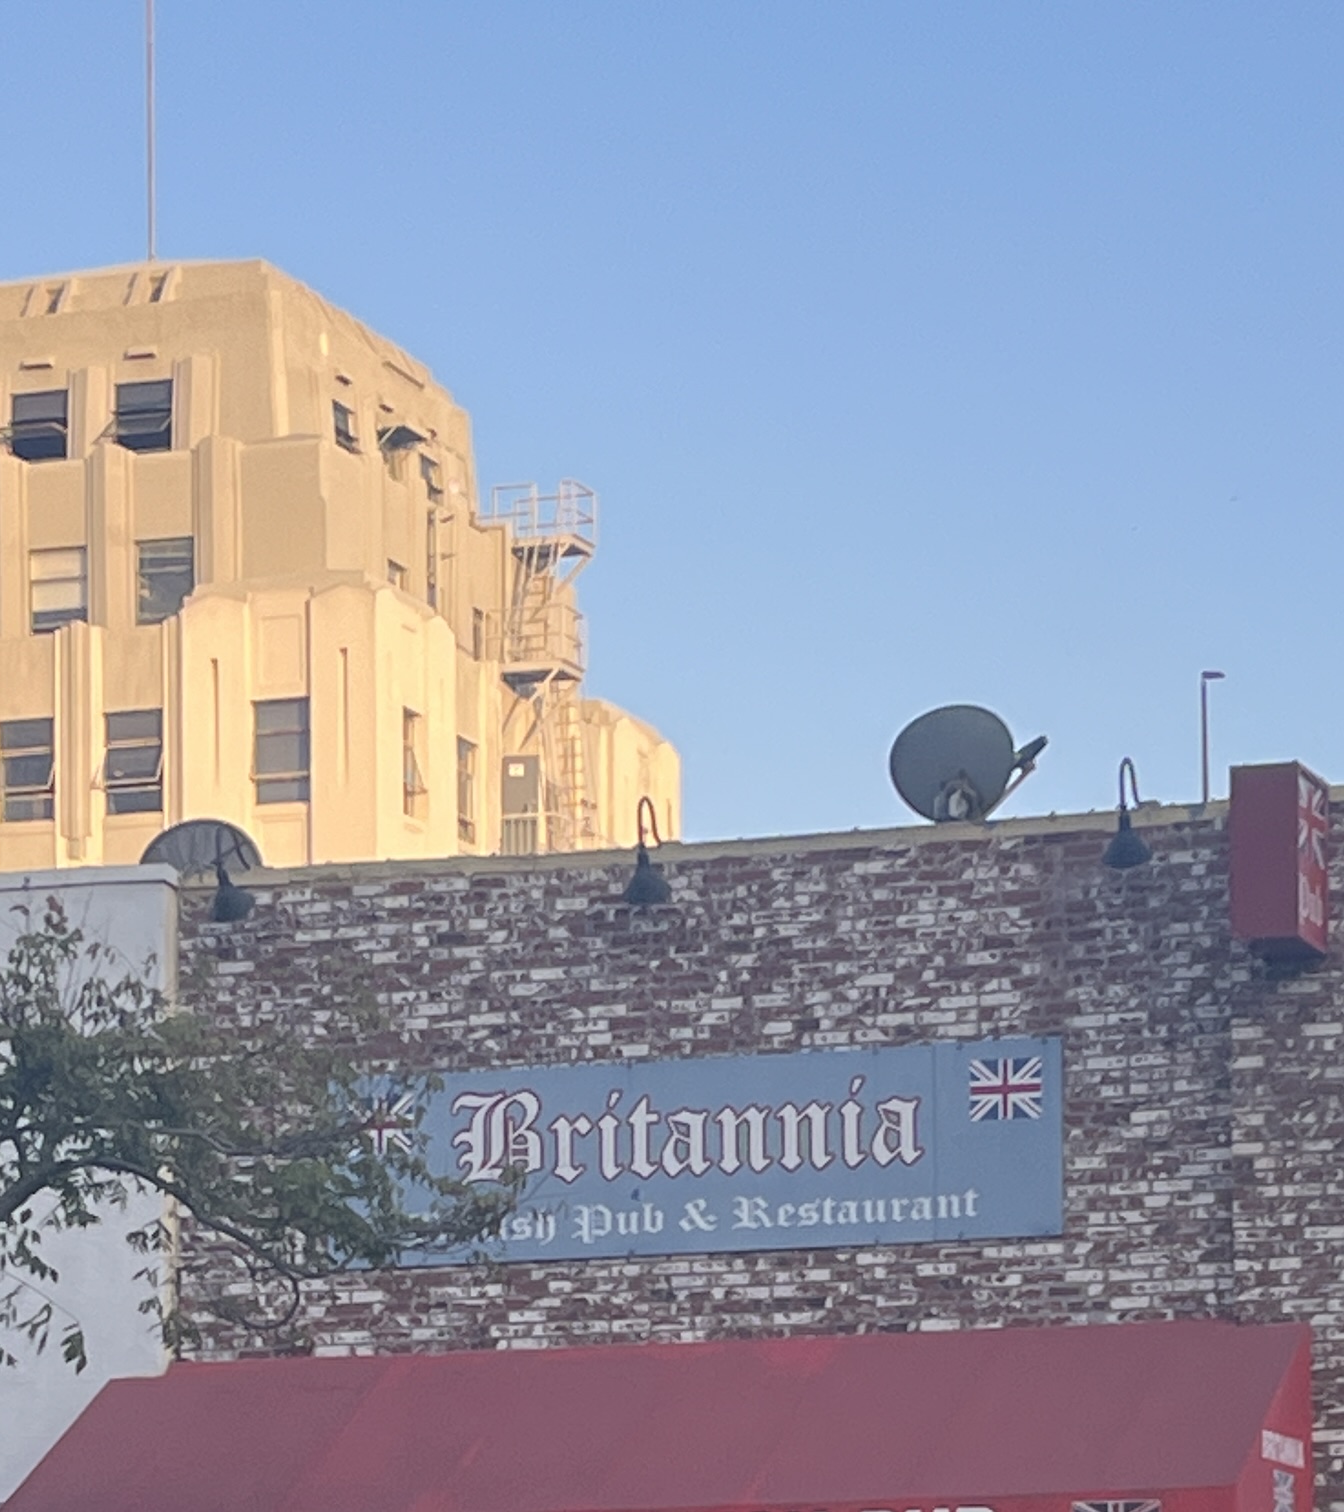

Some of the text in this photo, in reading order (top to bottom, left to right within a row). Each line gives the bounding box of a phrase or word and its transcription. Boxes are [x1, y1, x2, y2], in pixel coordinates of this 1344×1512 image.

[451, 1076, 923, 1186] Britannia
[573, 1205, 664, 1244] Pub
[677, 1200, 718, 1234] &
[731, 1188, 979, 1231] Restaurant
